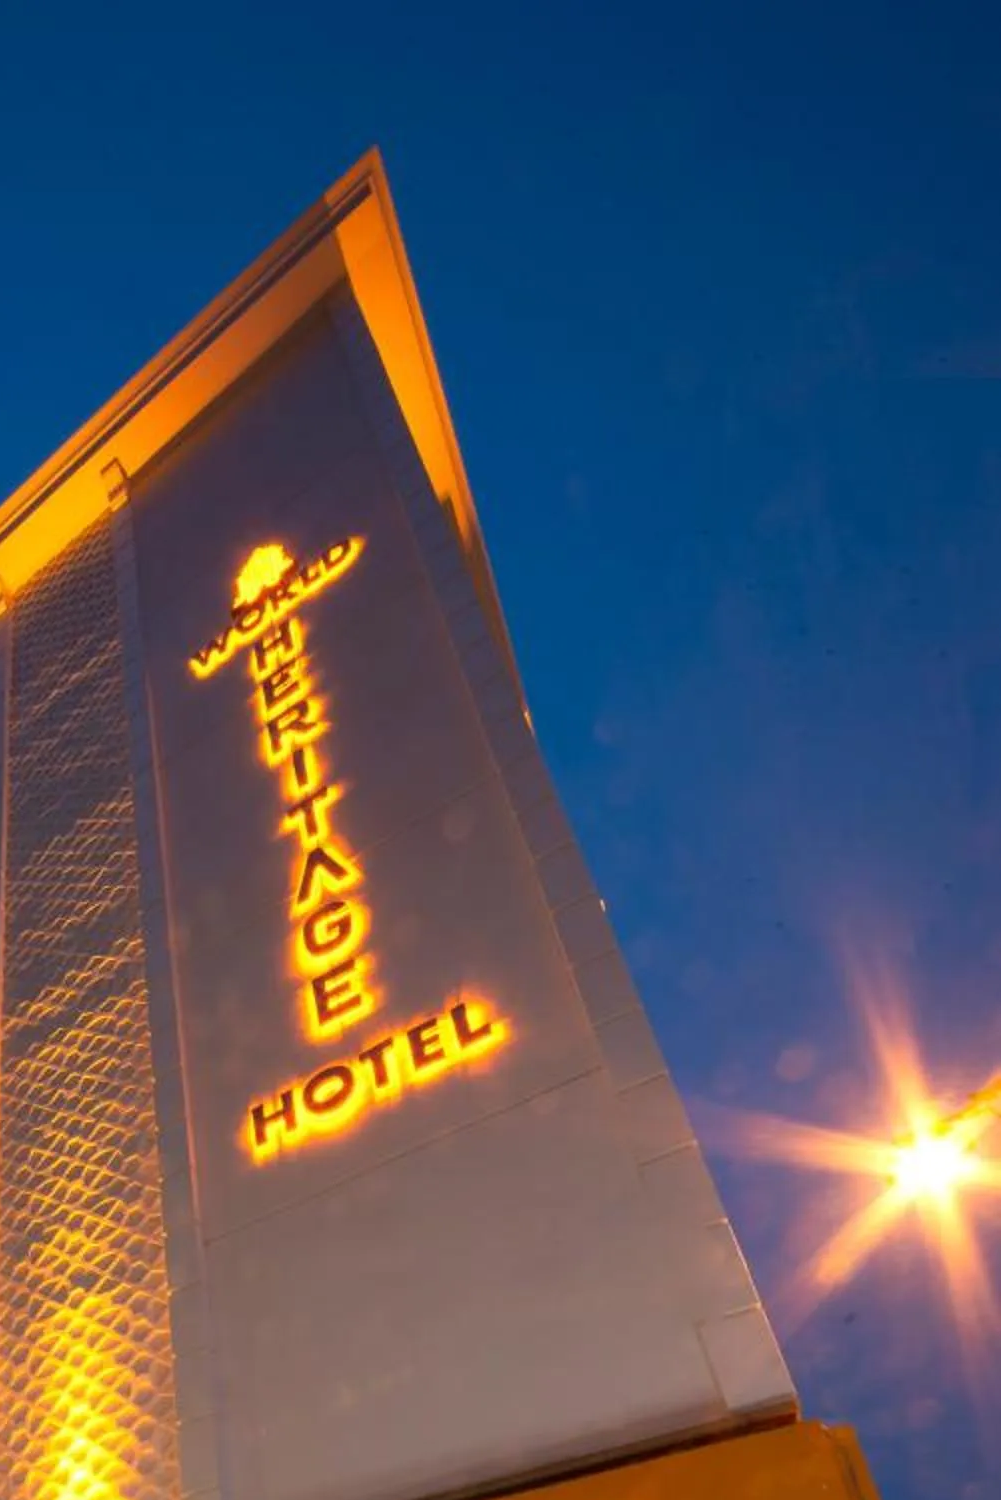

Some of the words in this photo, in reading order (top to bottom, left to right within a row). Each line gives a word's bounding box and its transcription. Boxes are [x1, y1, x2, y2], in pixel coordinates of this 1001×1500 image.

[190, 536, 359, 673] WORLD
[251, 616, 365, 1030] HERITAGE
[249, 1000, 496, 1152] HOTEL
